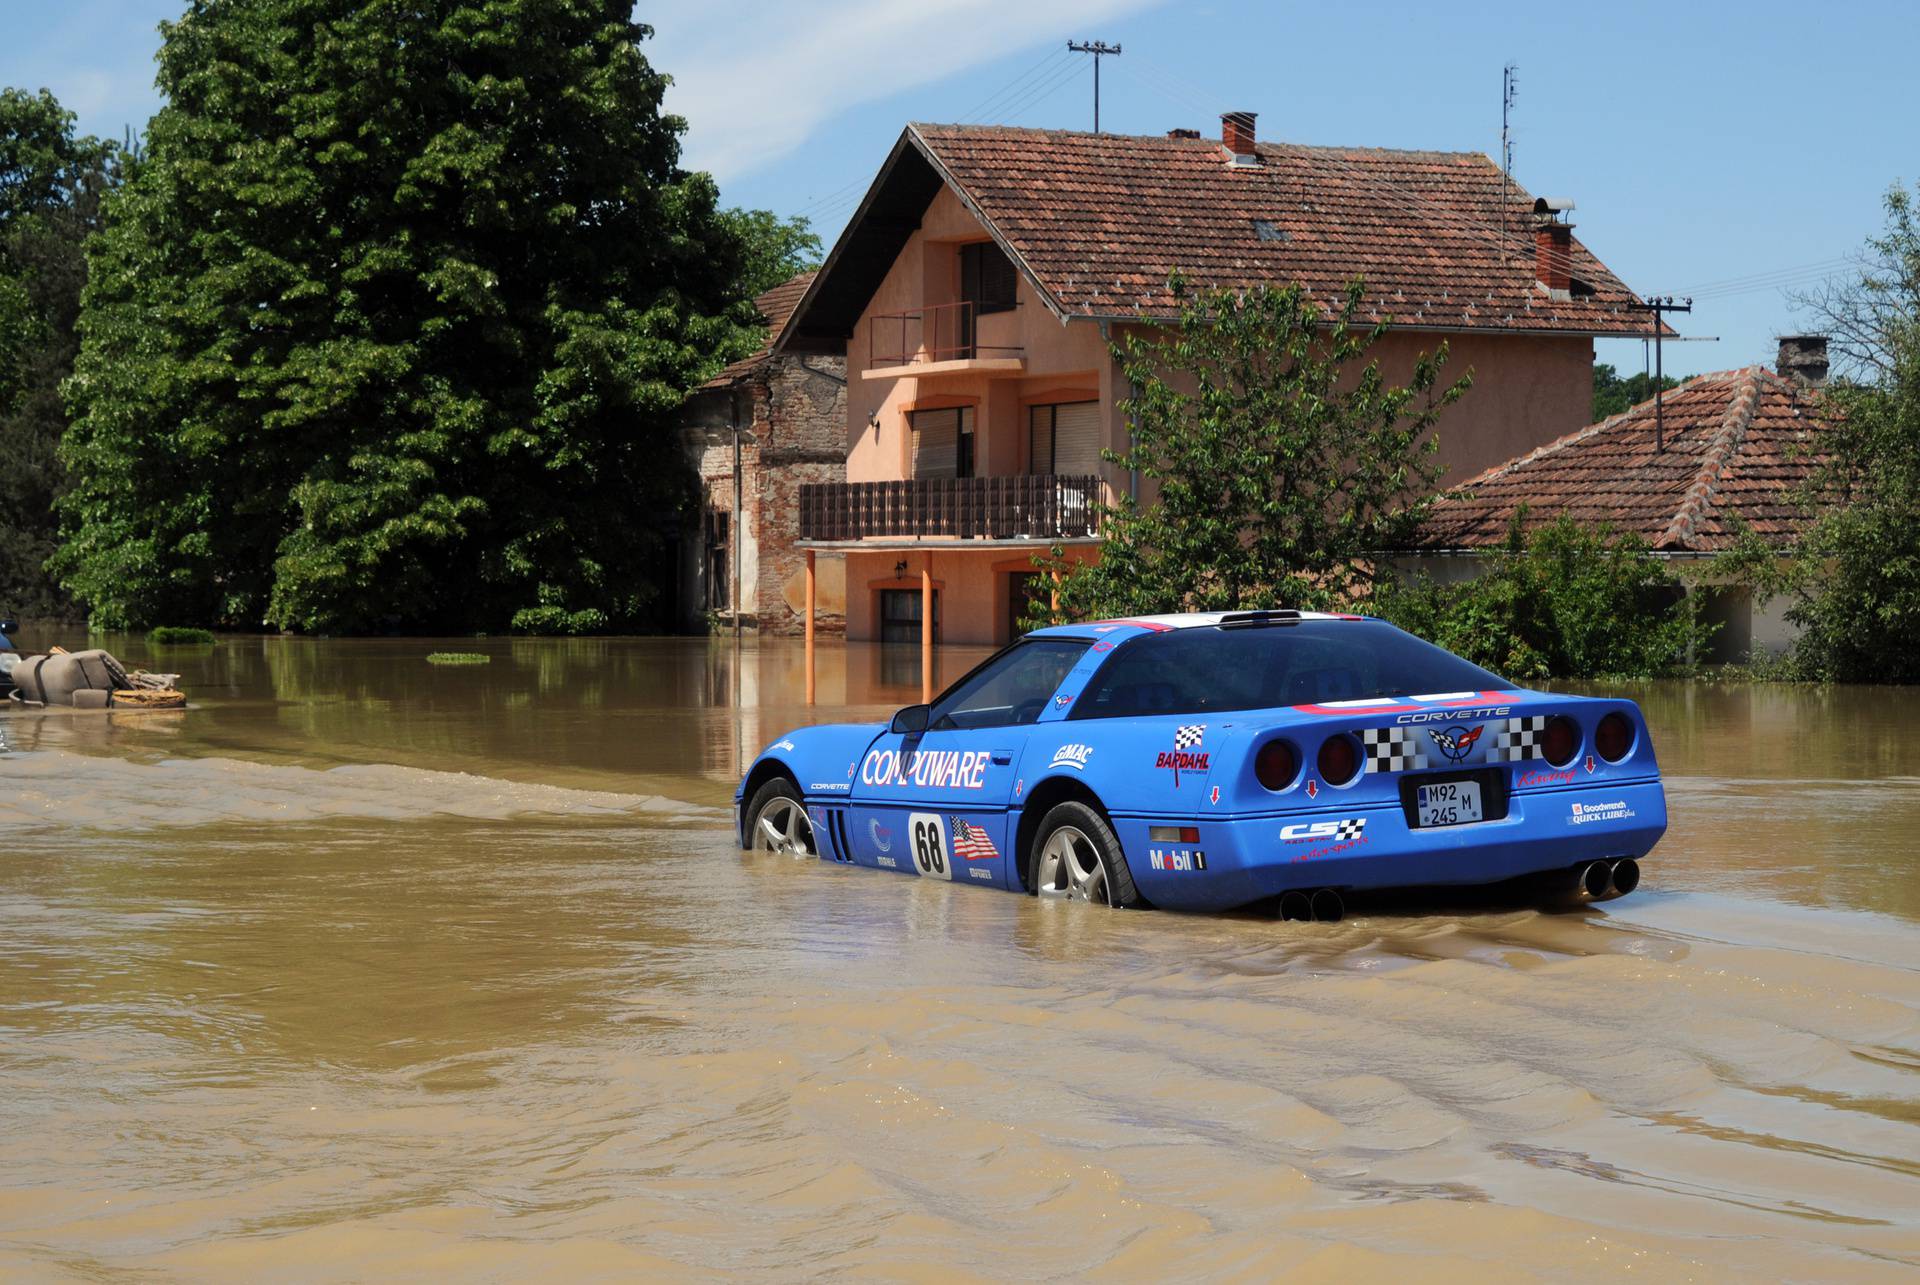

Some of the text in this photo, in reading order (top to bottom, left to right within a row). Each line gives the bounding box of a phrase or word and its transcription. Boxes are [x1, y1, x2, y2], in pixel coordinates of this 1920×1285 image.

[1397, 706, 1511, 724] CORVETTE
[1053, 743, 1094, 764] GMAC
[1155, 752, 1210, 769] BARDAHL
[1429, 784, 1472, 810] M92 M
[1431, 807, 1457, 825] 245
[1573, 813, 1601, 824] QUICK
[1280, 822, 1339, 839] C5
[915, 821, 944, 873] 68
[1150, 850, 1192, 870] Mobil
